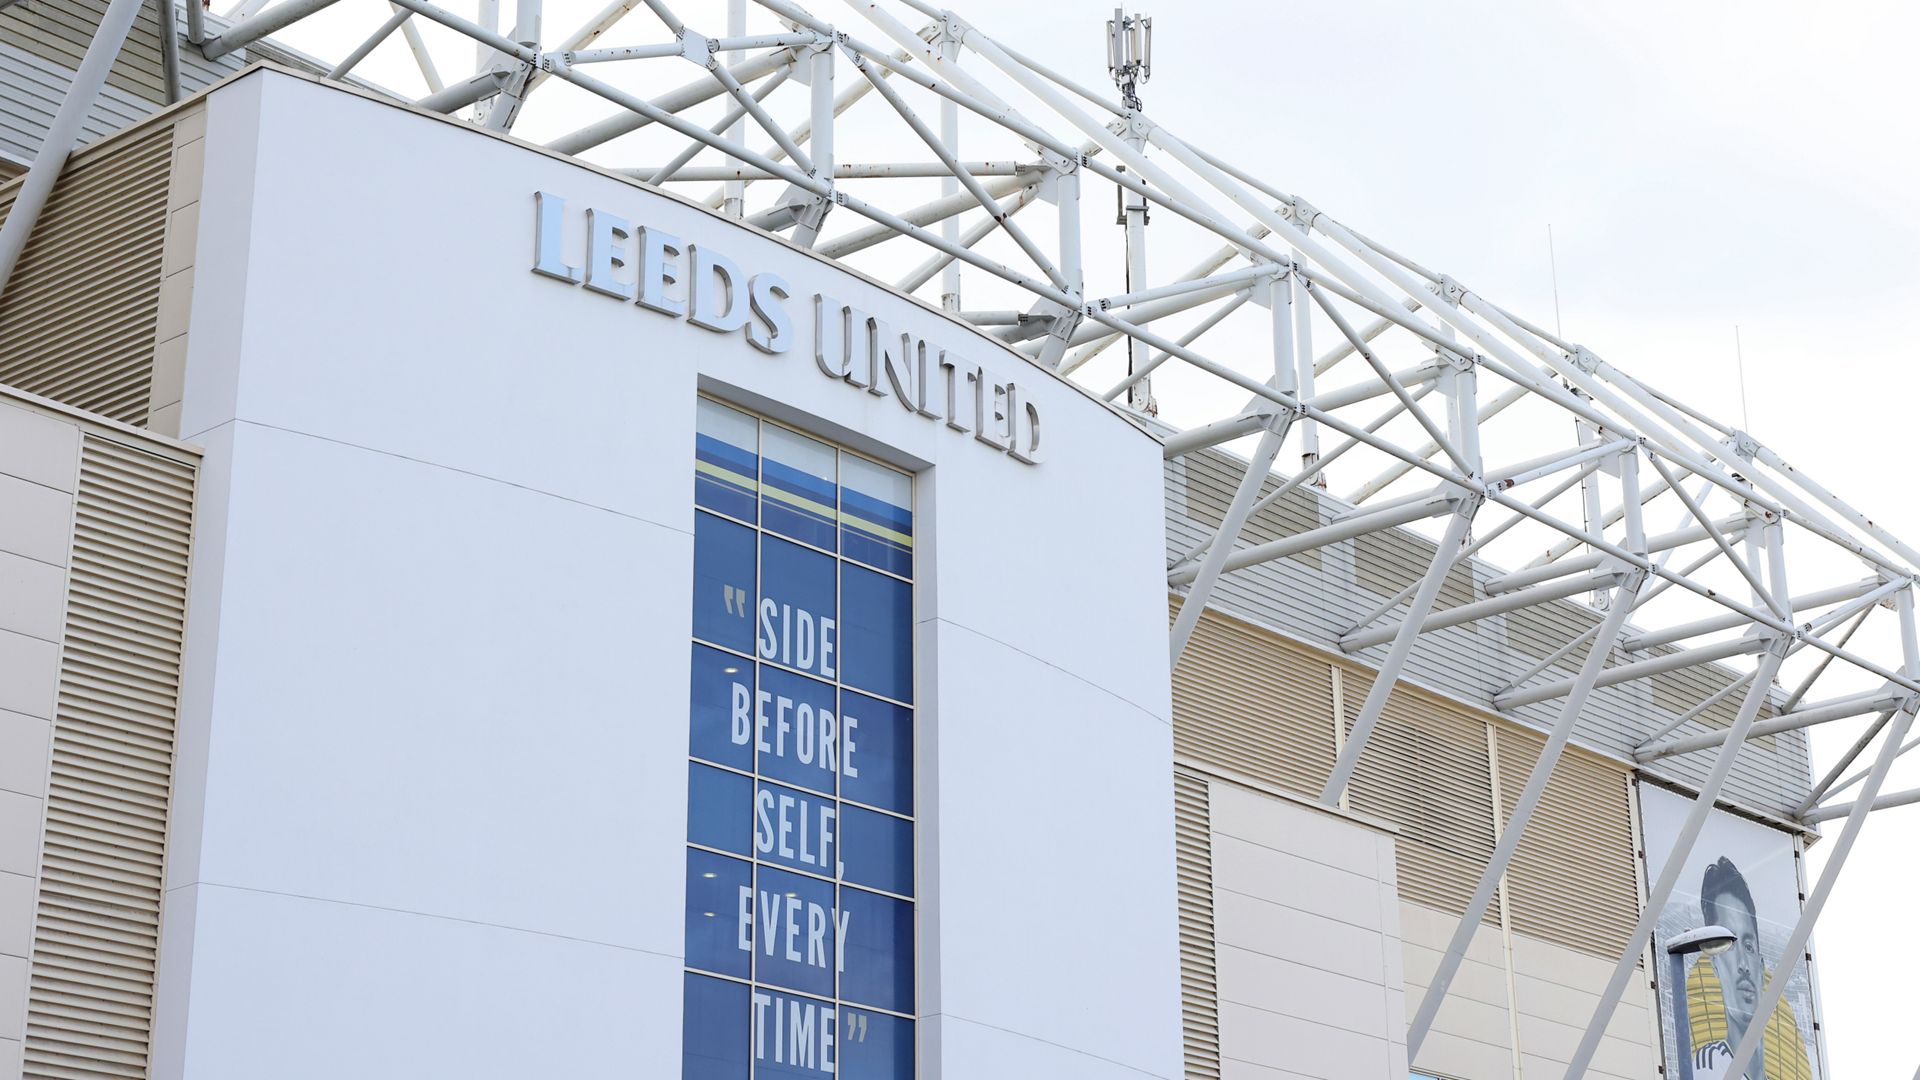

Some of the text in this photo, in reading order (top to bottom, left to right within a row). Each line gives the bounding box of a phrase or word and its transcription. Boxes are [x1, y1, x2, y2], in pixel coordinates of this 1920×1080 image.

[531, 190, 1047, 466] LEEDS UNITED
[731, 682, 858, 778] BEFORE
[756, 788, 845, 882] SELF,
[739, 885, 850, 972] EVERY
